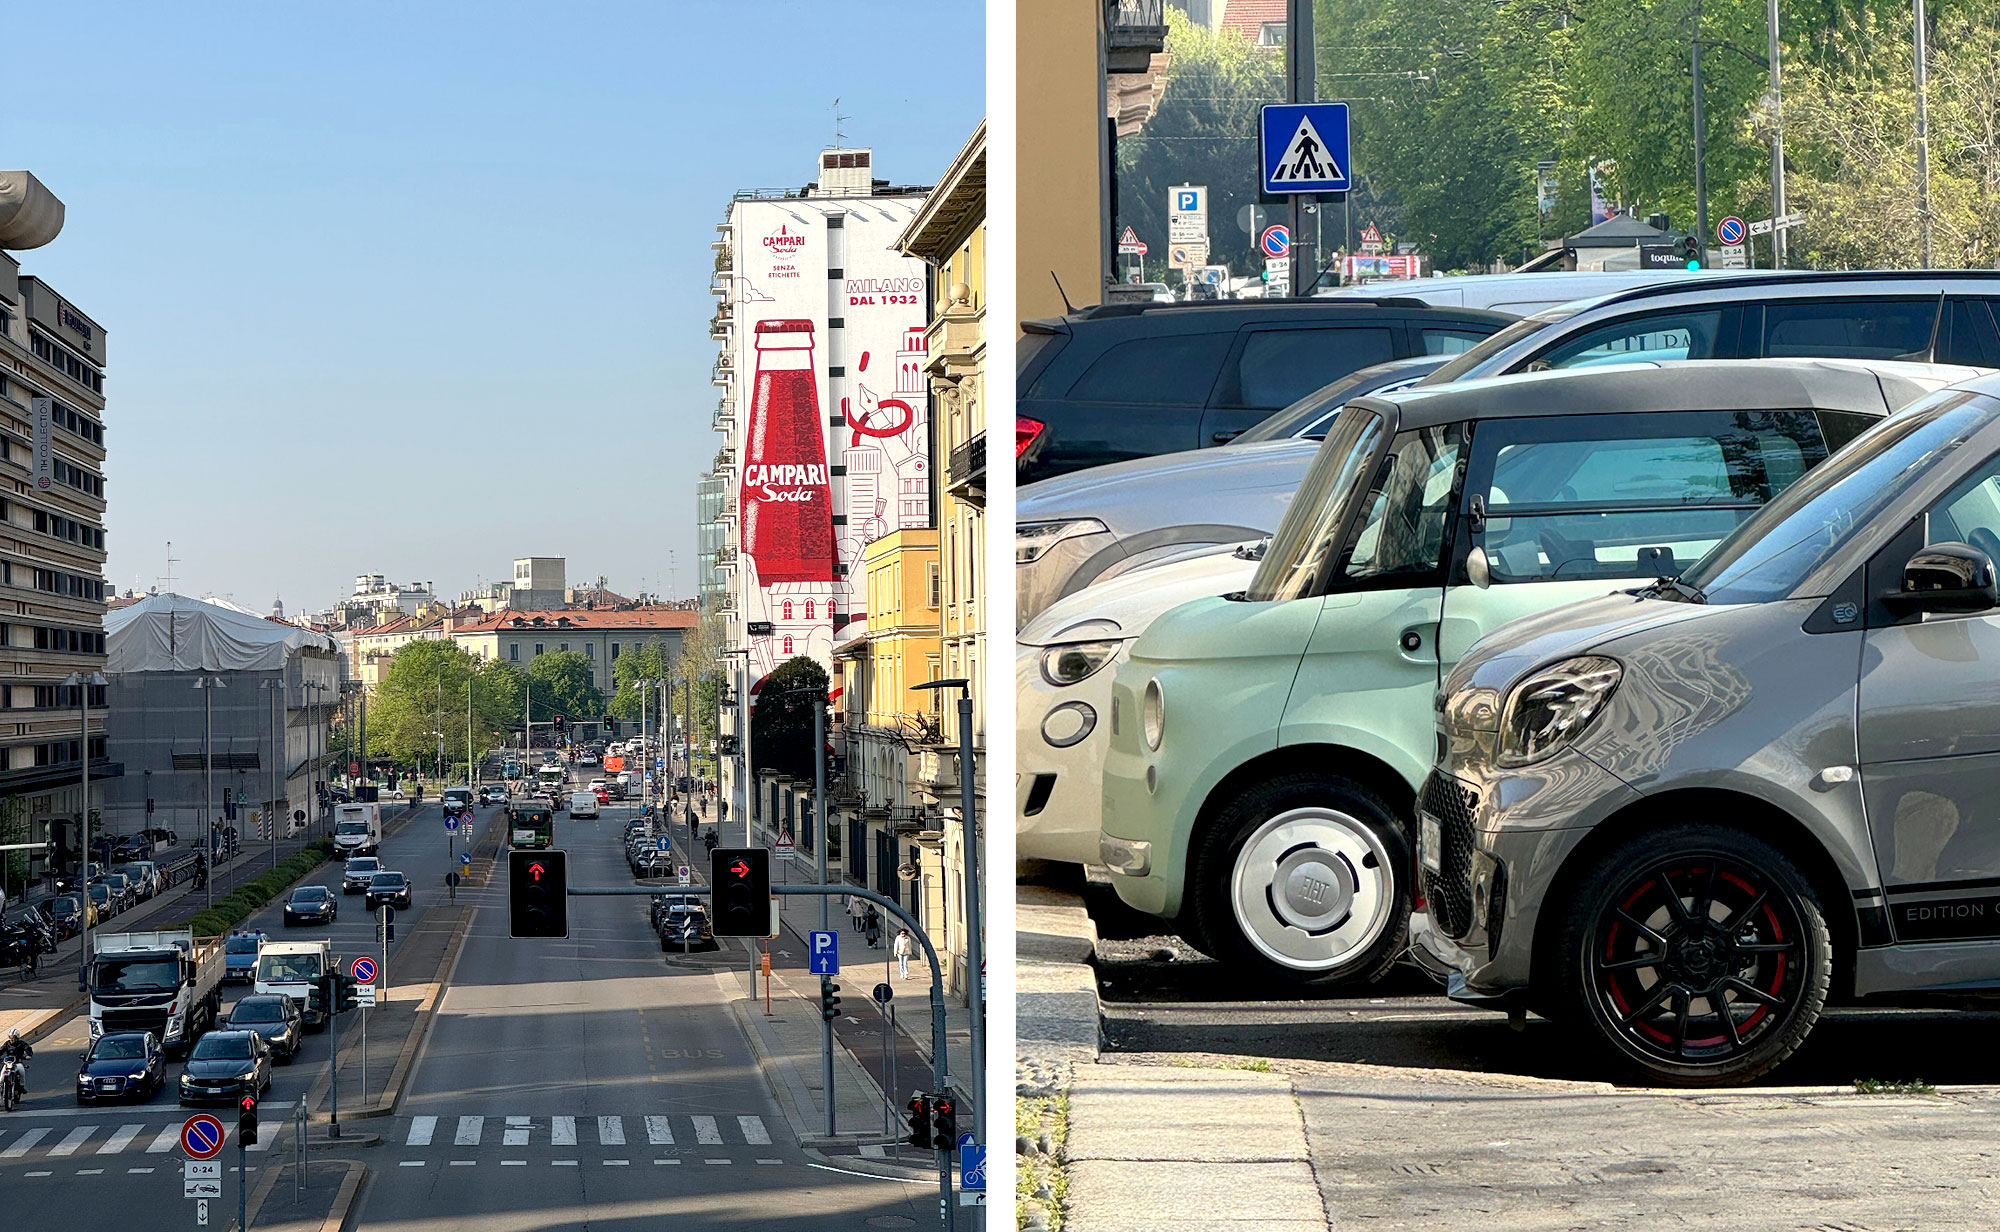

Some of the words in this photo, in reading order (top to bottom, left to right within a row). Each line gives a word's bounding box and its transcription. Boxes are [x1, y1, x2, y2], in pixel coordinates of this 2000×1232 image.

[1181, 194, 1194, 209] P
[762, 236, 805, 246] CAMPARI
[846, 278, 924, 293] MILANO
[850, 296, 875, 305] DAL
[881, 295, 917, 305] 1932
[40, 400, 48, 458] COLLECTION
[745, 463, 827, 487] CAMPARI
[756, 482, 813, 502] Soda
[1298, 876, 1330, 904] FIAT
[1906, 904, 1984, 921] EDITION
[815, 933, 832, 954] P
[661, 1048, 726, 1059] BUS
[192, 1165, 213, 1174] 0-24
